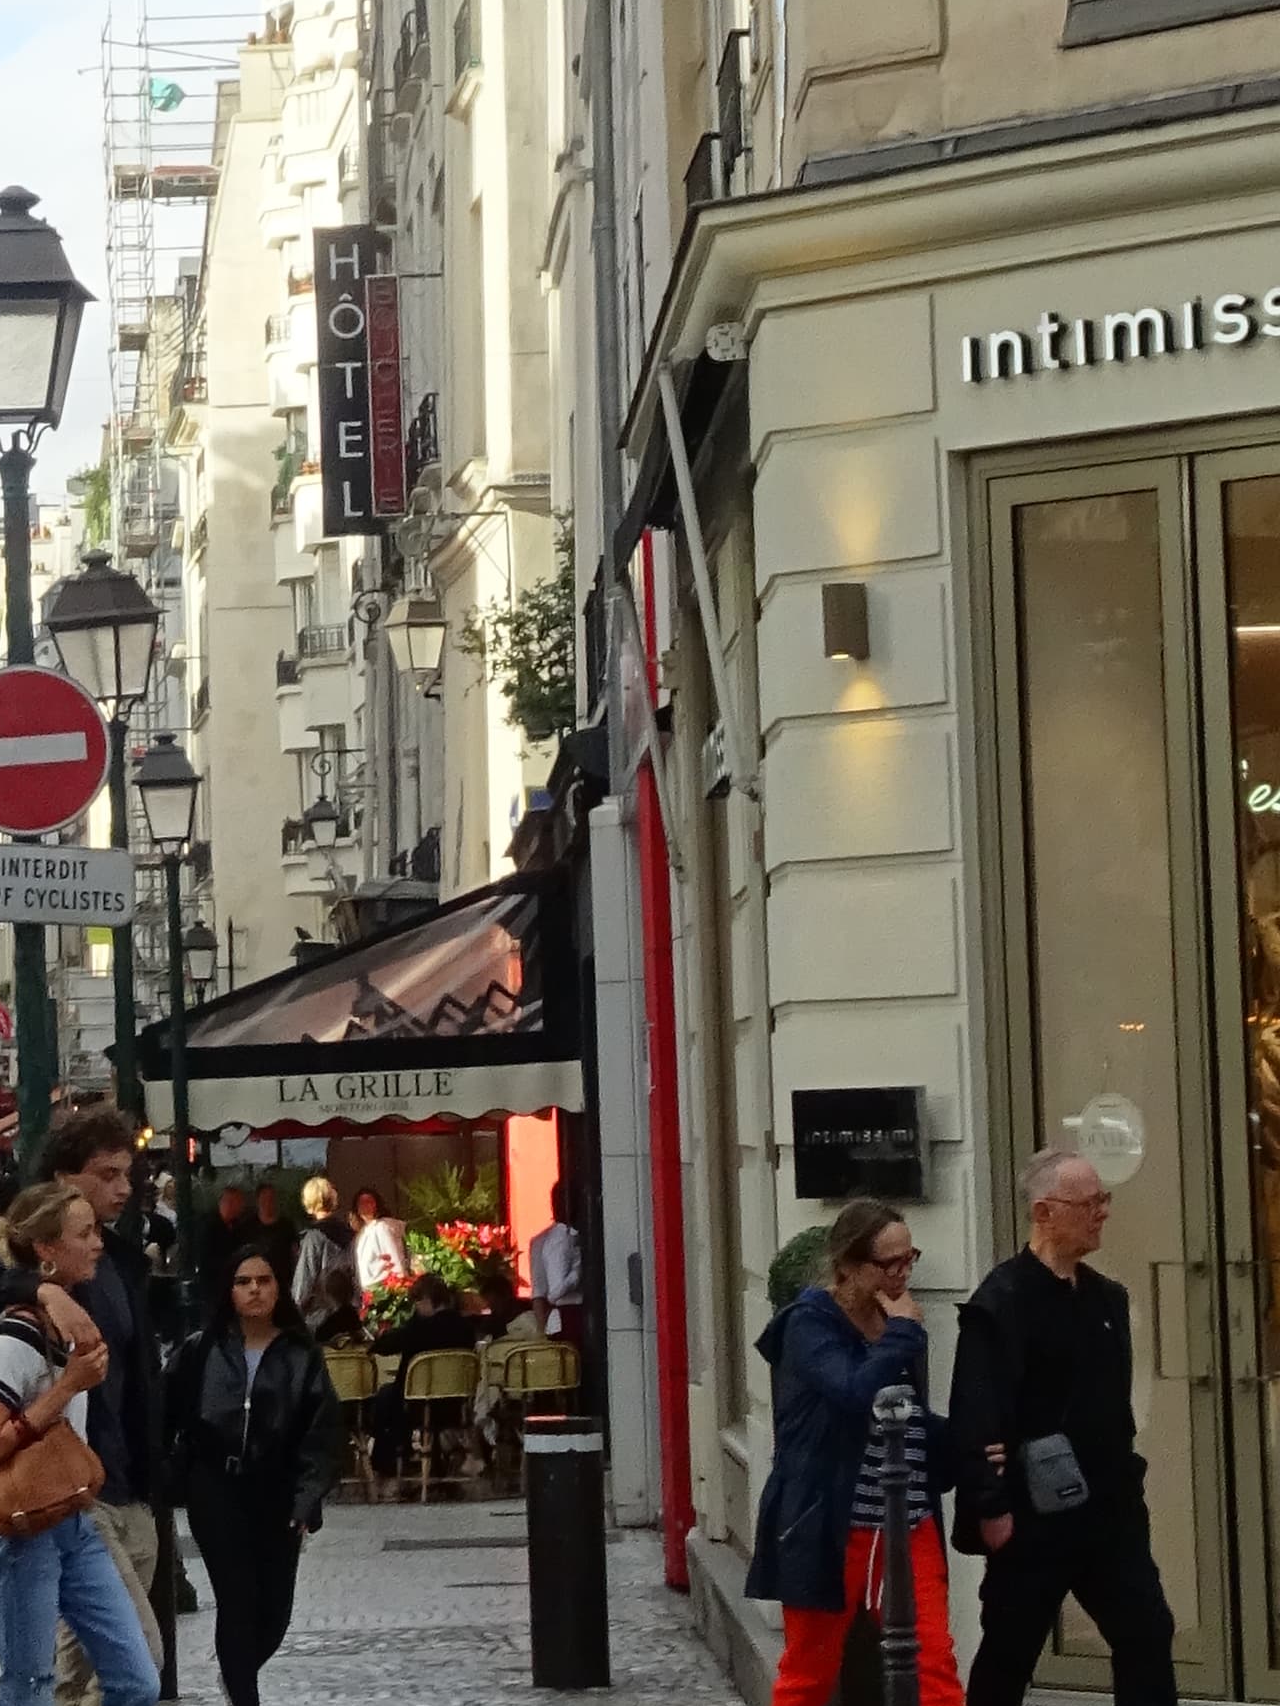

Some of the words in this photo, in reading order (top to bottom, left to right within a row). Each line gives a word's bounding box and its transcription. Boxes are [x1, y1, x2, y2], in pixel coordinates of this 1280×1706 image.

[328, 242, 365, 518] HÔTEL
[0, 857, 89, 881] INTERDIT
[24, 888, 126, 912] CYCLISTES
[278, 1077, 320, 1103] LA
[335, 1071, 454, 1099] GRILLE
